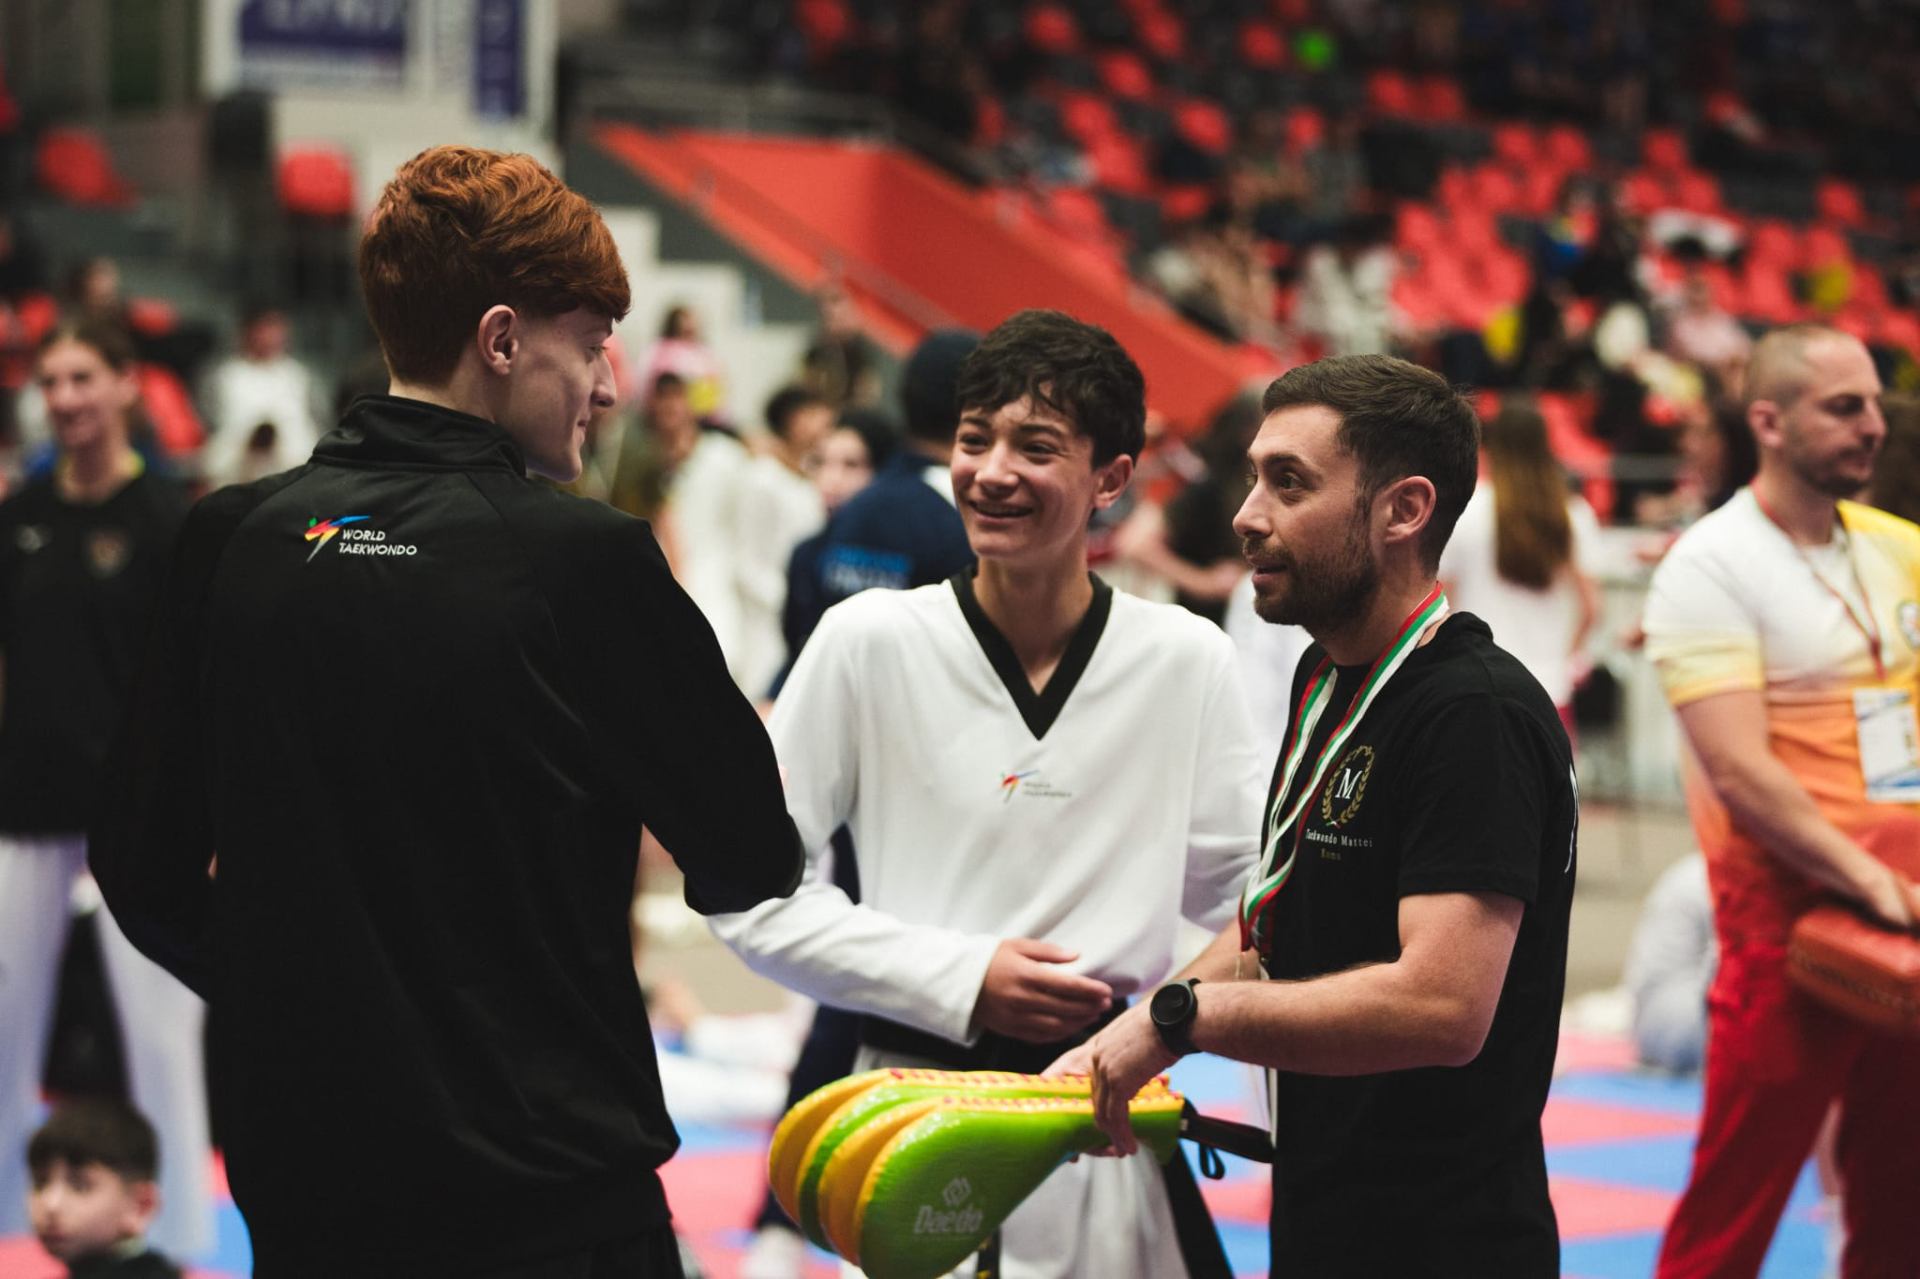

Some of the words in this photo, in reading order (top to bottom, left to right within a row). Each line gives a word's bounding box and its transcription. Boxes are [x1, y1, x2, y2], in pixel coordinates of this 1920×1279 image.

[342, 528, 386, 541] WORLD
[339, 542, 418, 556] TAEKWONDO
[1334, 767, 1363, 799] M
[1341, 834, 1373, 848] Mattei
